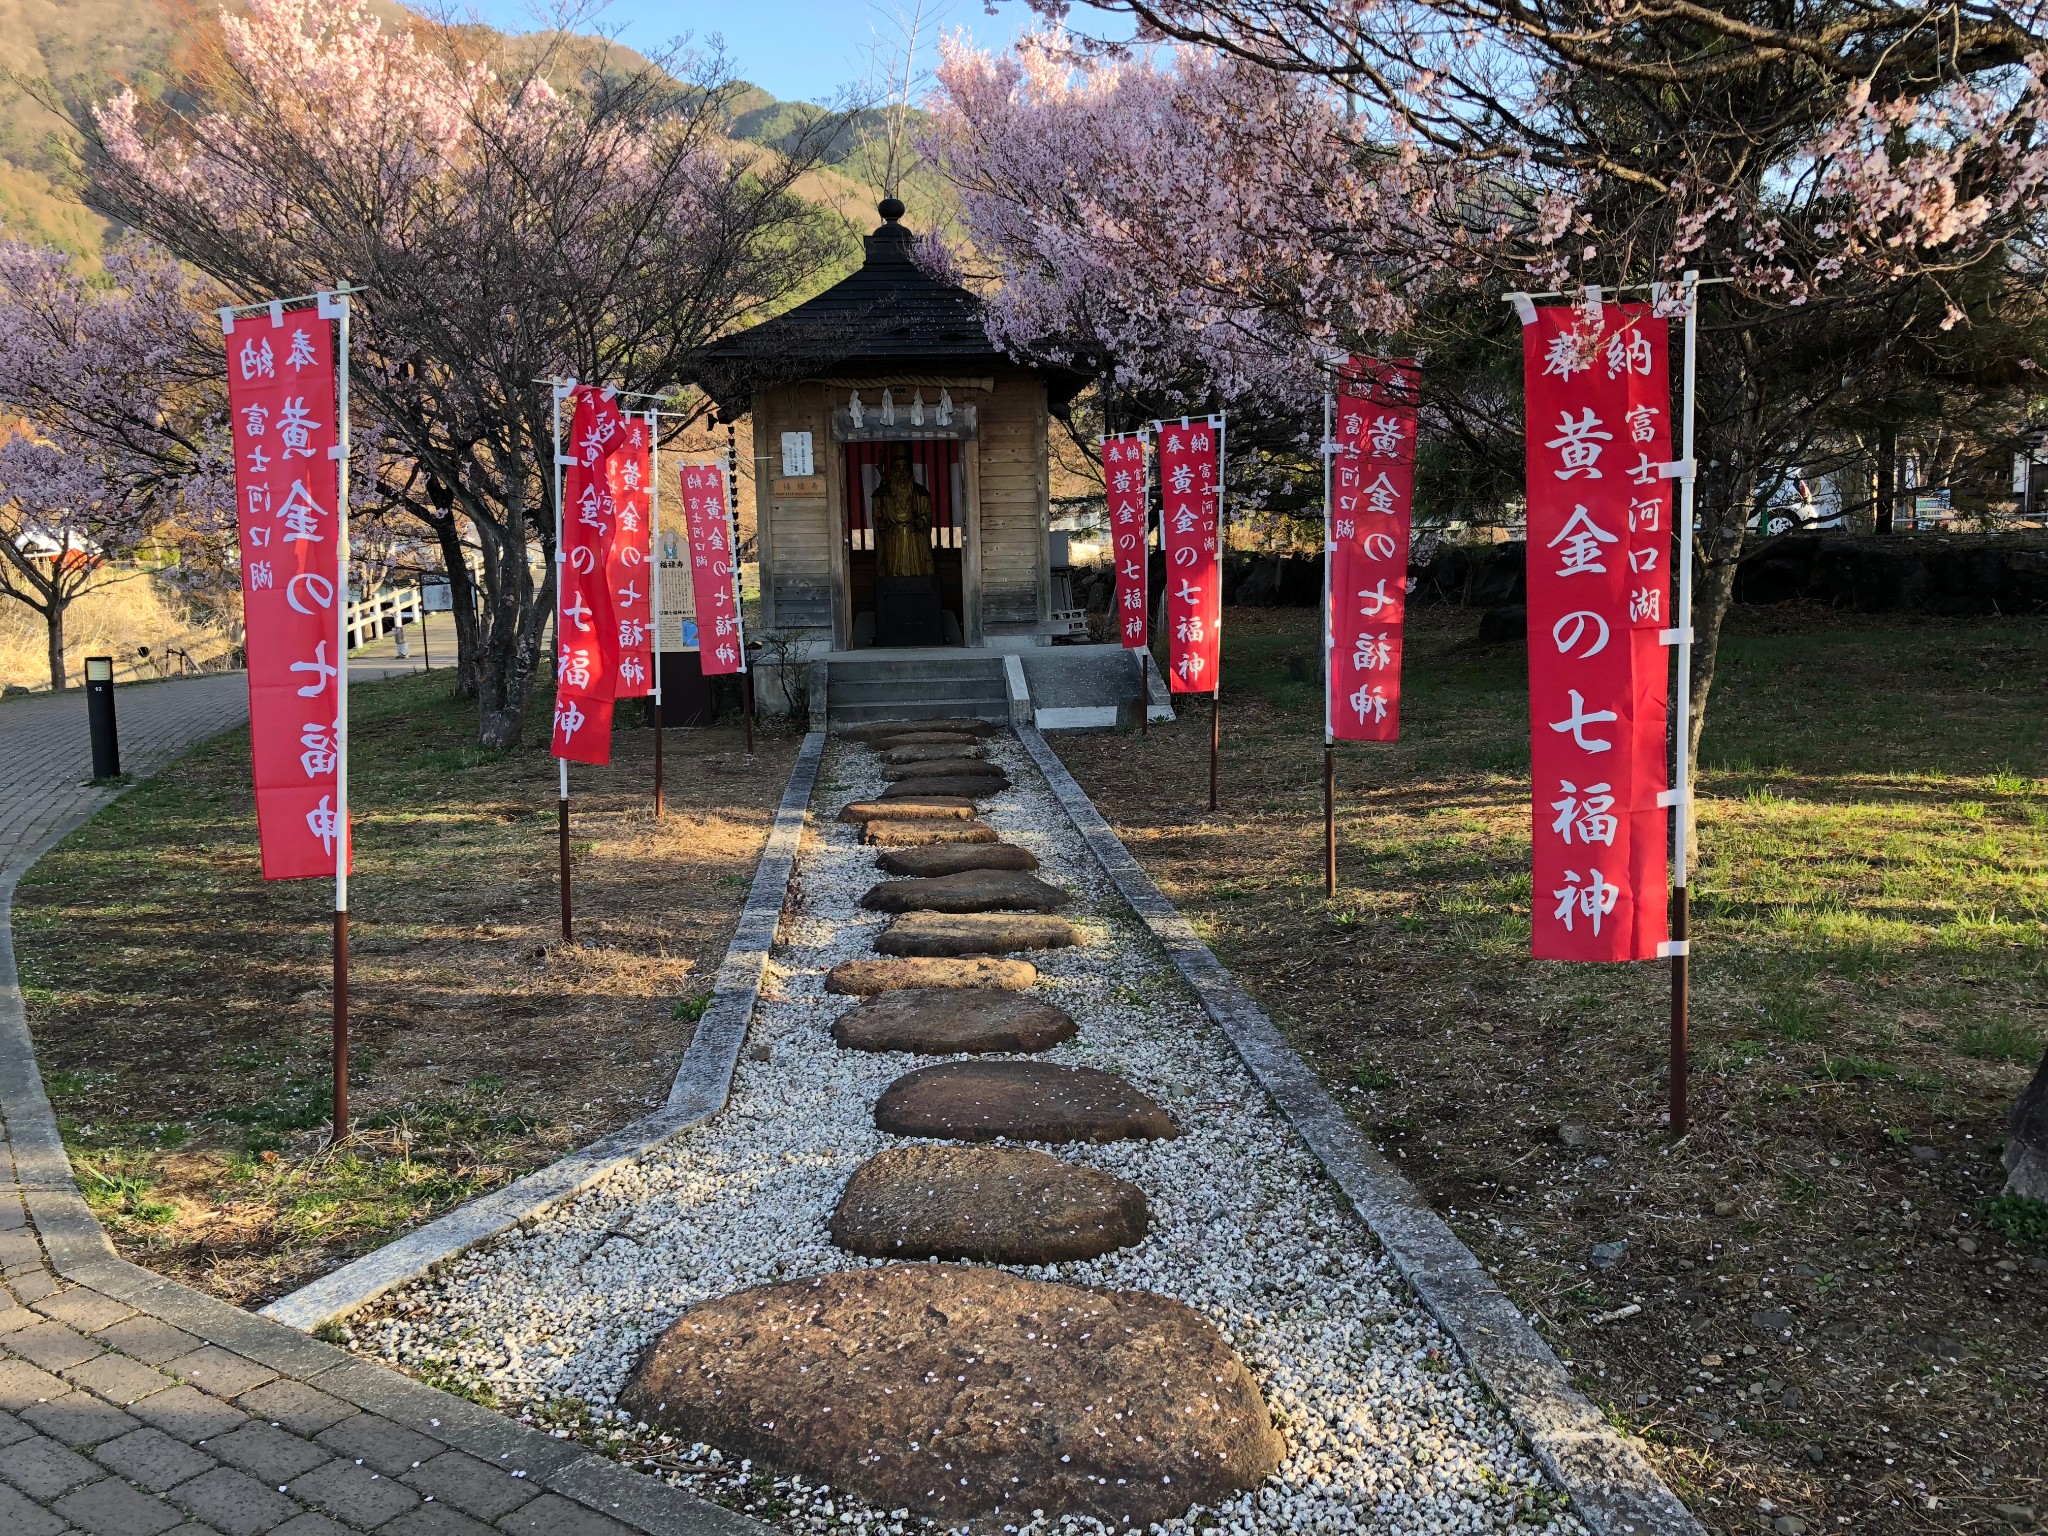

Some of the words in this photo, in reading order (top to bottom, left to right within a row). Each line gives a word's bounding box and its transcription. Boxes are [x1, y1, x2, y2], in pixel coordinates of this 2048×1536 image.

[1108, 445, 1140, 463] 奉納
[1165, 432, 1209, 455] 奉納
[1198, 463, 1215, 551] 富士河口湖
[1624, 403, 1663, 623] 富士河口湖
[1111, 470, 1143, 639] 黄金の七福神
[1169, 464, 1205, 681] 黄金の七福神
[1544, 406, 1619, 937] 黄金の七福神
